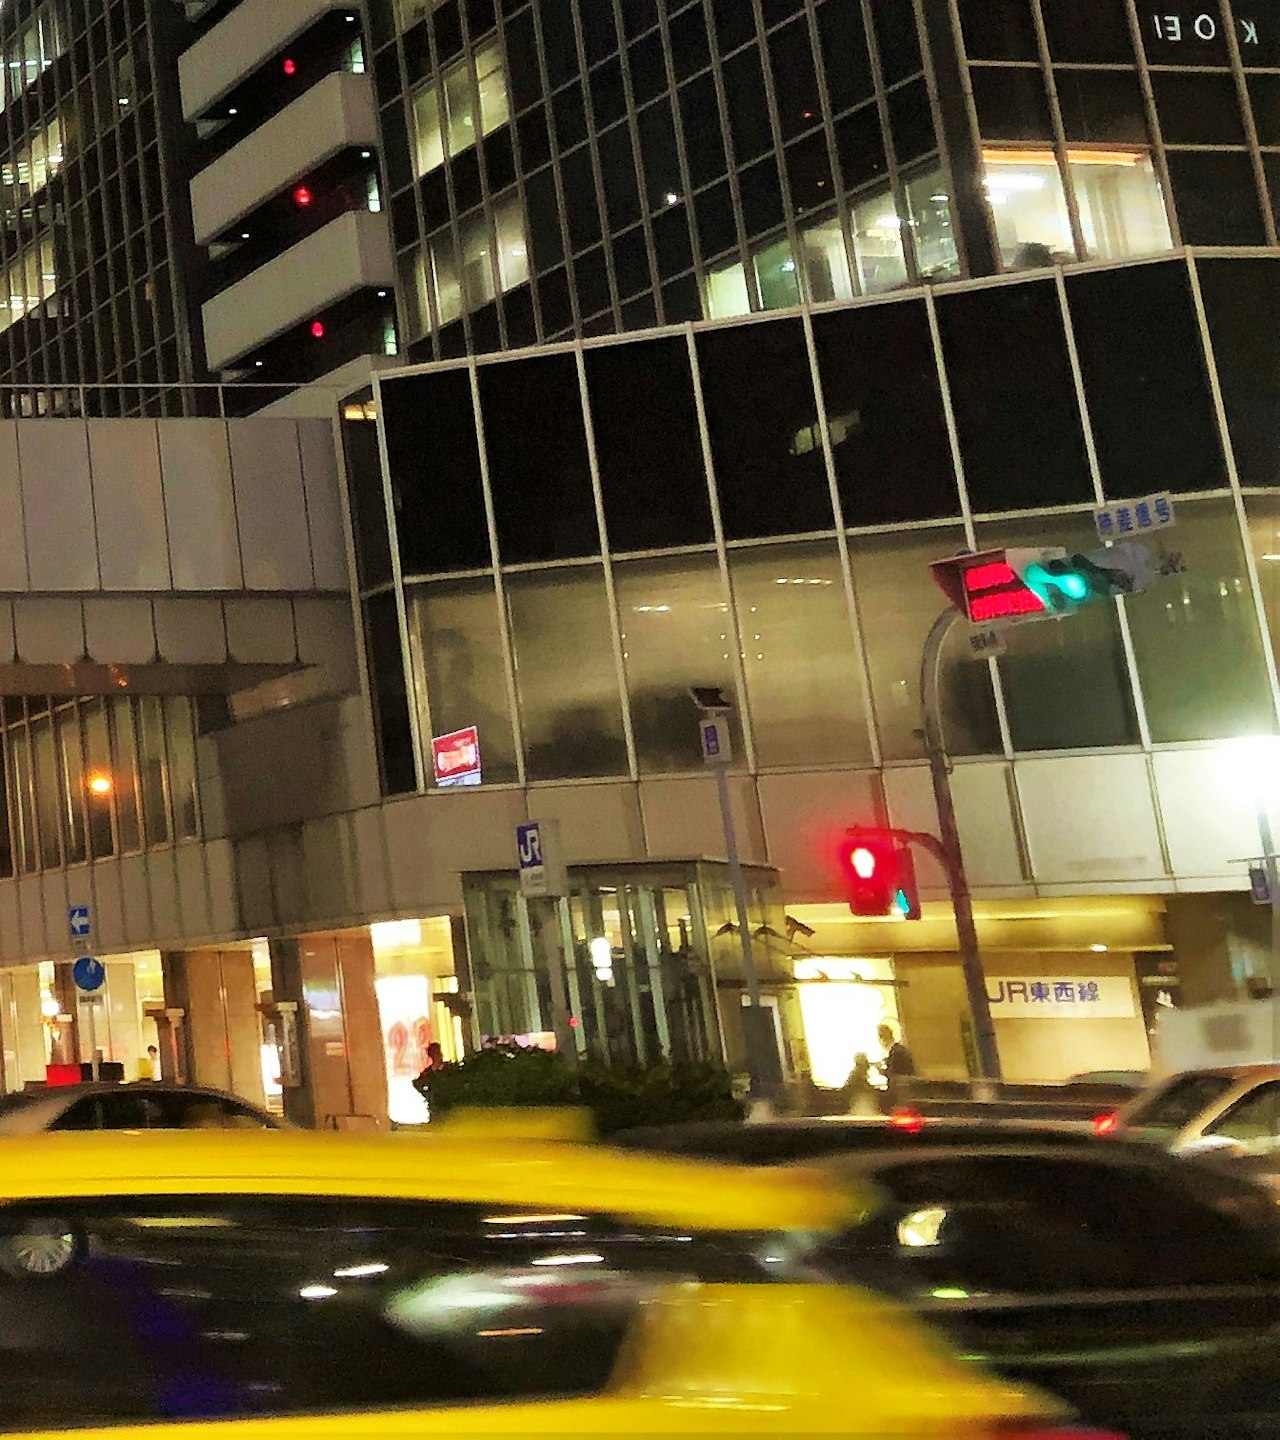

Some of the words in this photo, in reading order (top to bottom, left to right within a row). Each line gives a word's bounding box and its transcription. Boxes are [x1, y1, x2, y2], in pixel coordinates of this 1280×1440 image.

[520, 829, 543, 863] JR
[989, 981, 1101, 1004] JR東西線
